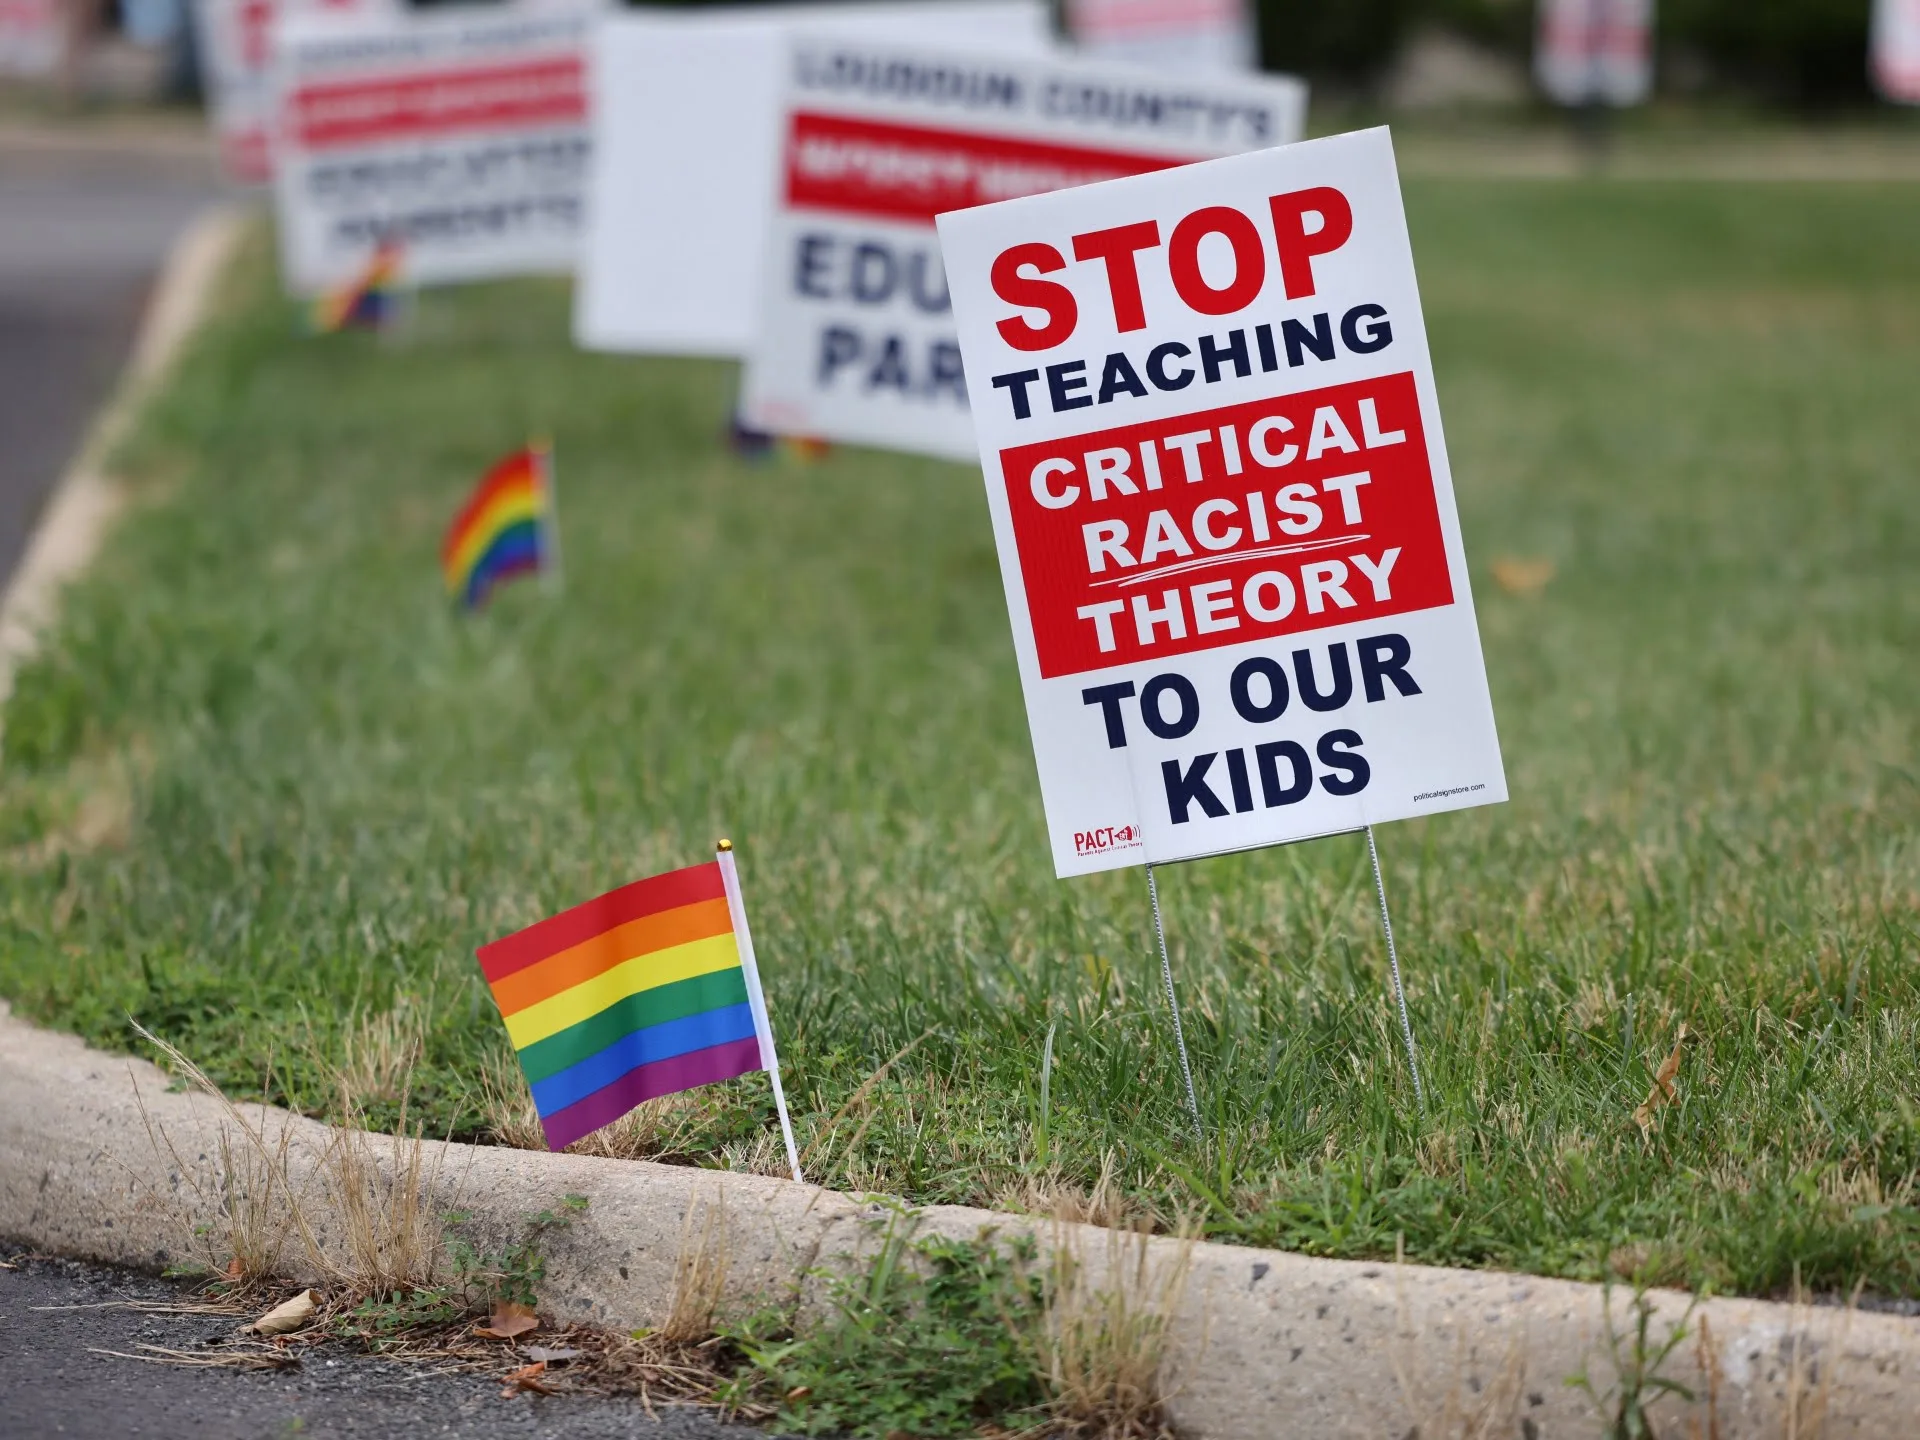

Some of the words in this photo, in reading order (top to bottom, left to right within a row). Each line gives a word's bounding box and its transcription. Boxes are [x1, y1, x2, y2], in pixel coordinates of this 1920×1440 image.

[991, 186, 1353, 352] STOP
[992, 303, 1393, 419] TEACHING
[1029, 398, 1406, 510] CRITICAL
[1082, 471, 1371, 573] RACIST
[1077, 547, 1402, 653] THEORY
[1082, 673, 1200, 749] TO
[1230, 633, 1422, 724] OUR
[1161, 728, 1371, 825] KIDS
[1413, 783, 1486, 802] politicalsignstore.com
[1074, 827, 1114, 851] PACT
